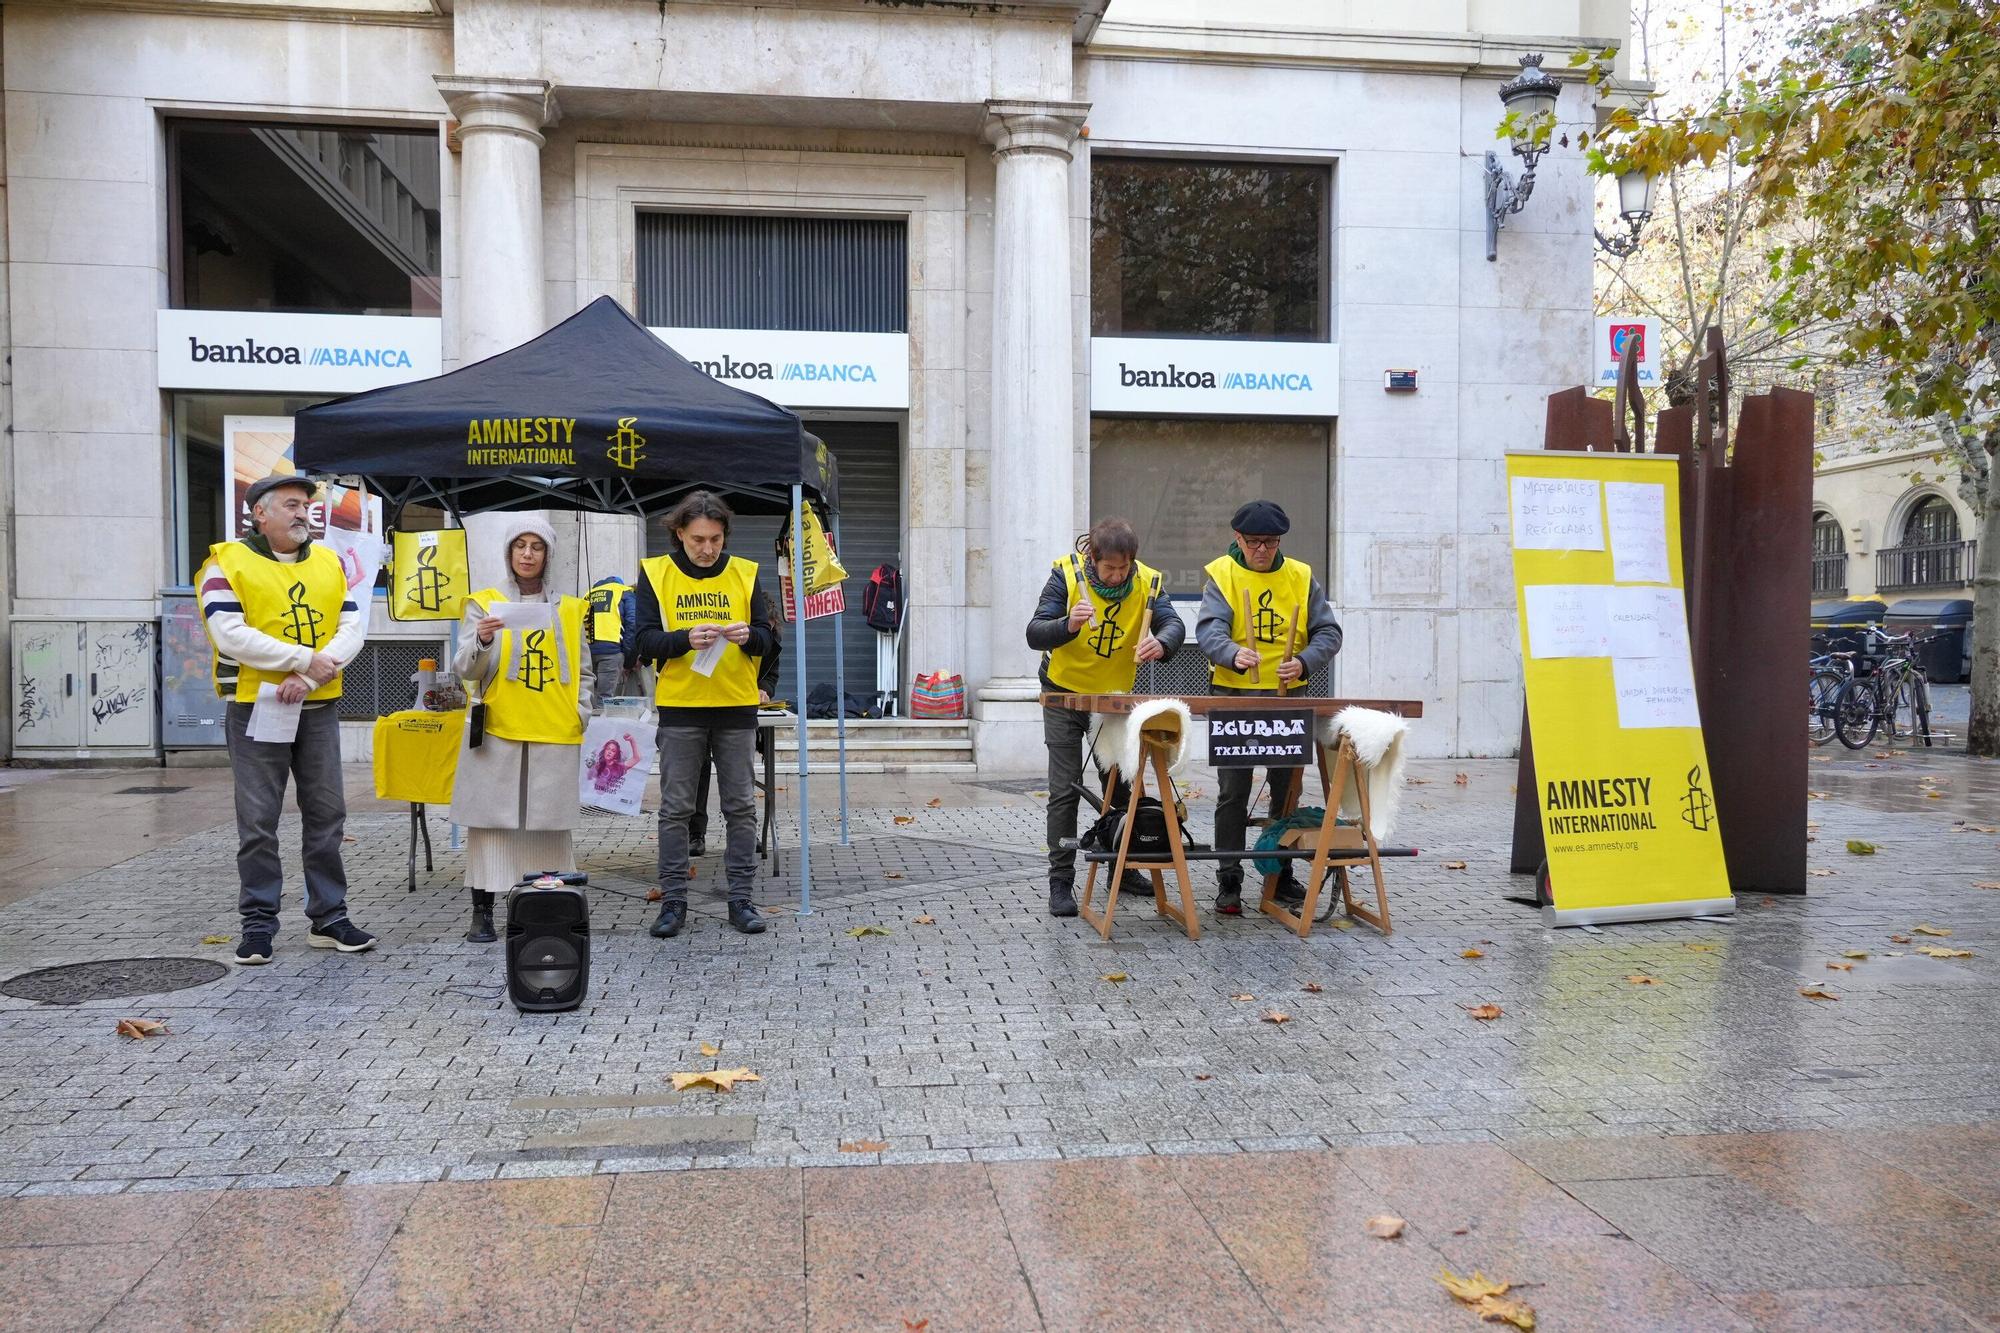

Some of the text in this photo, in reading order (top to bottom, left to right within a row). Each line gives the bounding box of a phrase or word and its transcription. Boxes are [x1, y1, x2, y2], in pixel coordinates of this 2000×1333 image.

[189, 336, 301, 365] bankoa
[1119, 363, 1216, 388] bankoa
[467, 418, 576, 445] AMNESTY
[467, 448, 576, 465] INTERNATIONAL
[1522, 505, 1586, 516] DE LONAS
[676, 592, 731, 609] AMNISTÍA
[676, 611, 732, 621] INTERNACIONAL
[1211, 720, 1305, 736] EGURRA
[1214, 745, 1302, 756] TXALAPARTA
[1547, 777, 1651, 810] AMNESTY
[1549, 812, 1656, 834] INTERNATIONAL
[1553, 840, 1639, 853] www.es.amnesty.org
